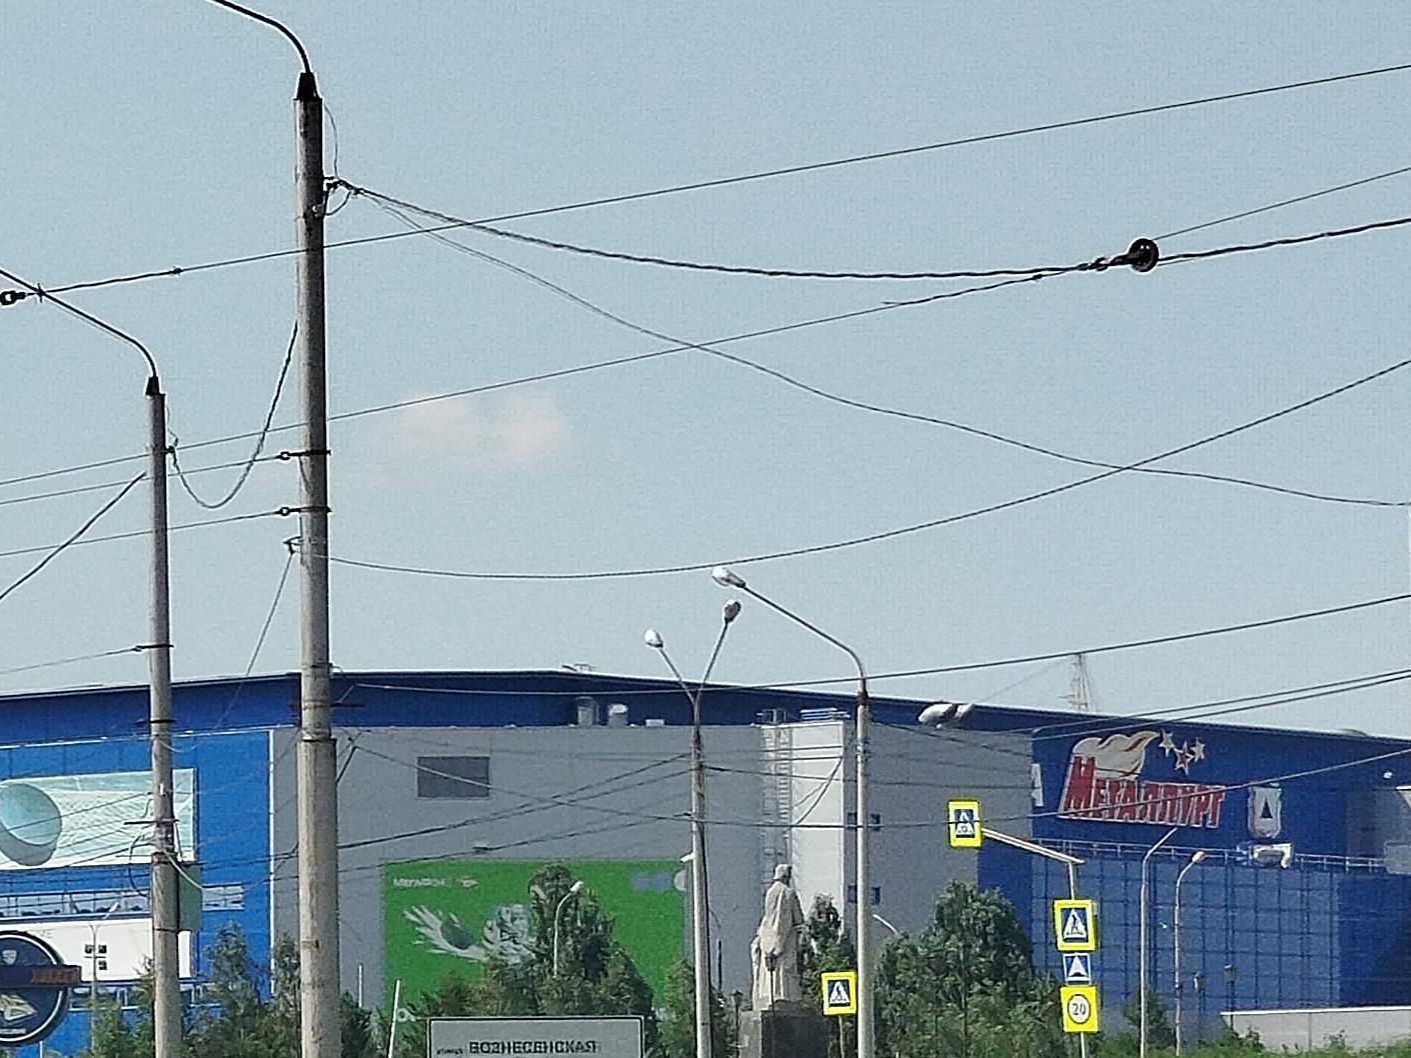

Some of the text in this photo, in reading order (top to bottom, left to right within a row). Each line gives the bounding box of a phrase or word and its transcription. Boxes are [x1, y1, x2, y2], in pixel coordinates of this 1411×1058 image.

[1058, 756, 1225, 828] МЕТАЛЛУРГ
[1072, 1003, 1086, 1015] 20
[470, 1041, 597, 1054] ВОЗНЕСЕНСКАЯ
